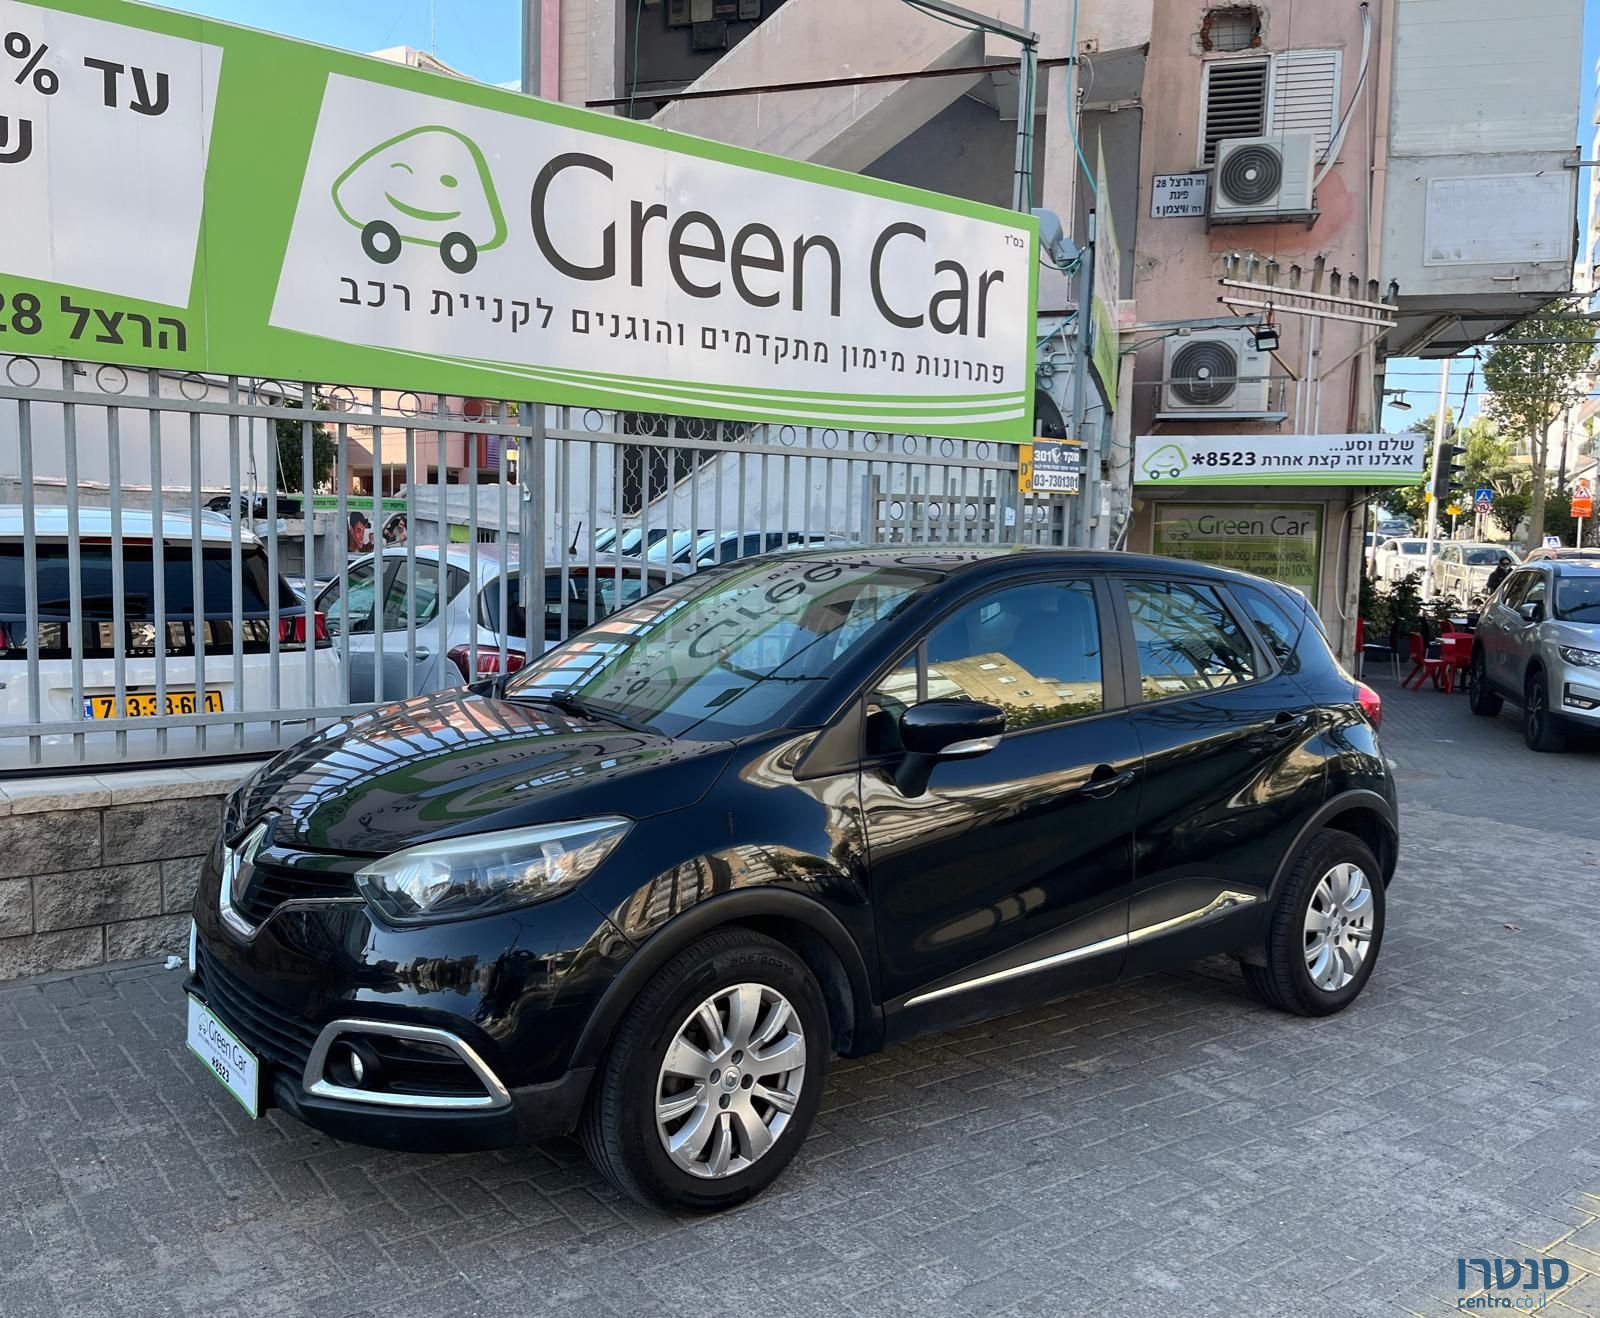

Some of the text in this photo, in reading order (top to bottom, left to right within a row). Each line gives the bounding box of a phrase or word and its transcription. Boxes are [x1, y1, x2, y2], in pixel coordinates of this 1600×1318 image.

[84, 57, 169, 116] עד
[1156, 179, 1167, 188] 28
[1169, 177, 1193, 187] הרצל
[1169, 190, 1189, 200] פינת
[1155, 206, 1160, 214] 1
[530, 152, 842, 317] Green
[869, 222, 1005, 338] Car
[0, 292, 187, 352] הרצל 8
[339, 276, 1004, 384] פתרונות מימון מתקדמים והוגנים לקניית רכב
[1328, 438, 1415, 452] שלם וסע...
[1034, 450, 1052, 462] 301
[1261, 452, 1413, 469] אצלנו זה קצת אחרת
[1034, 474, 1078, 489] 03-7301301
[1198, 515, 1309, 535] Green Car
[208, 1019, 231, 1059] Green
[232, 1044, 247, 1074] Car
